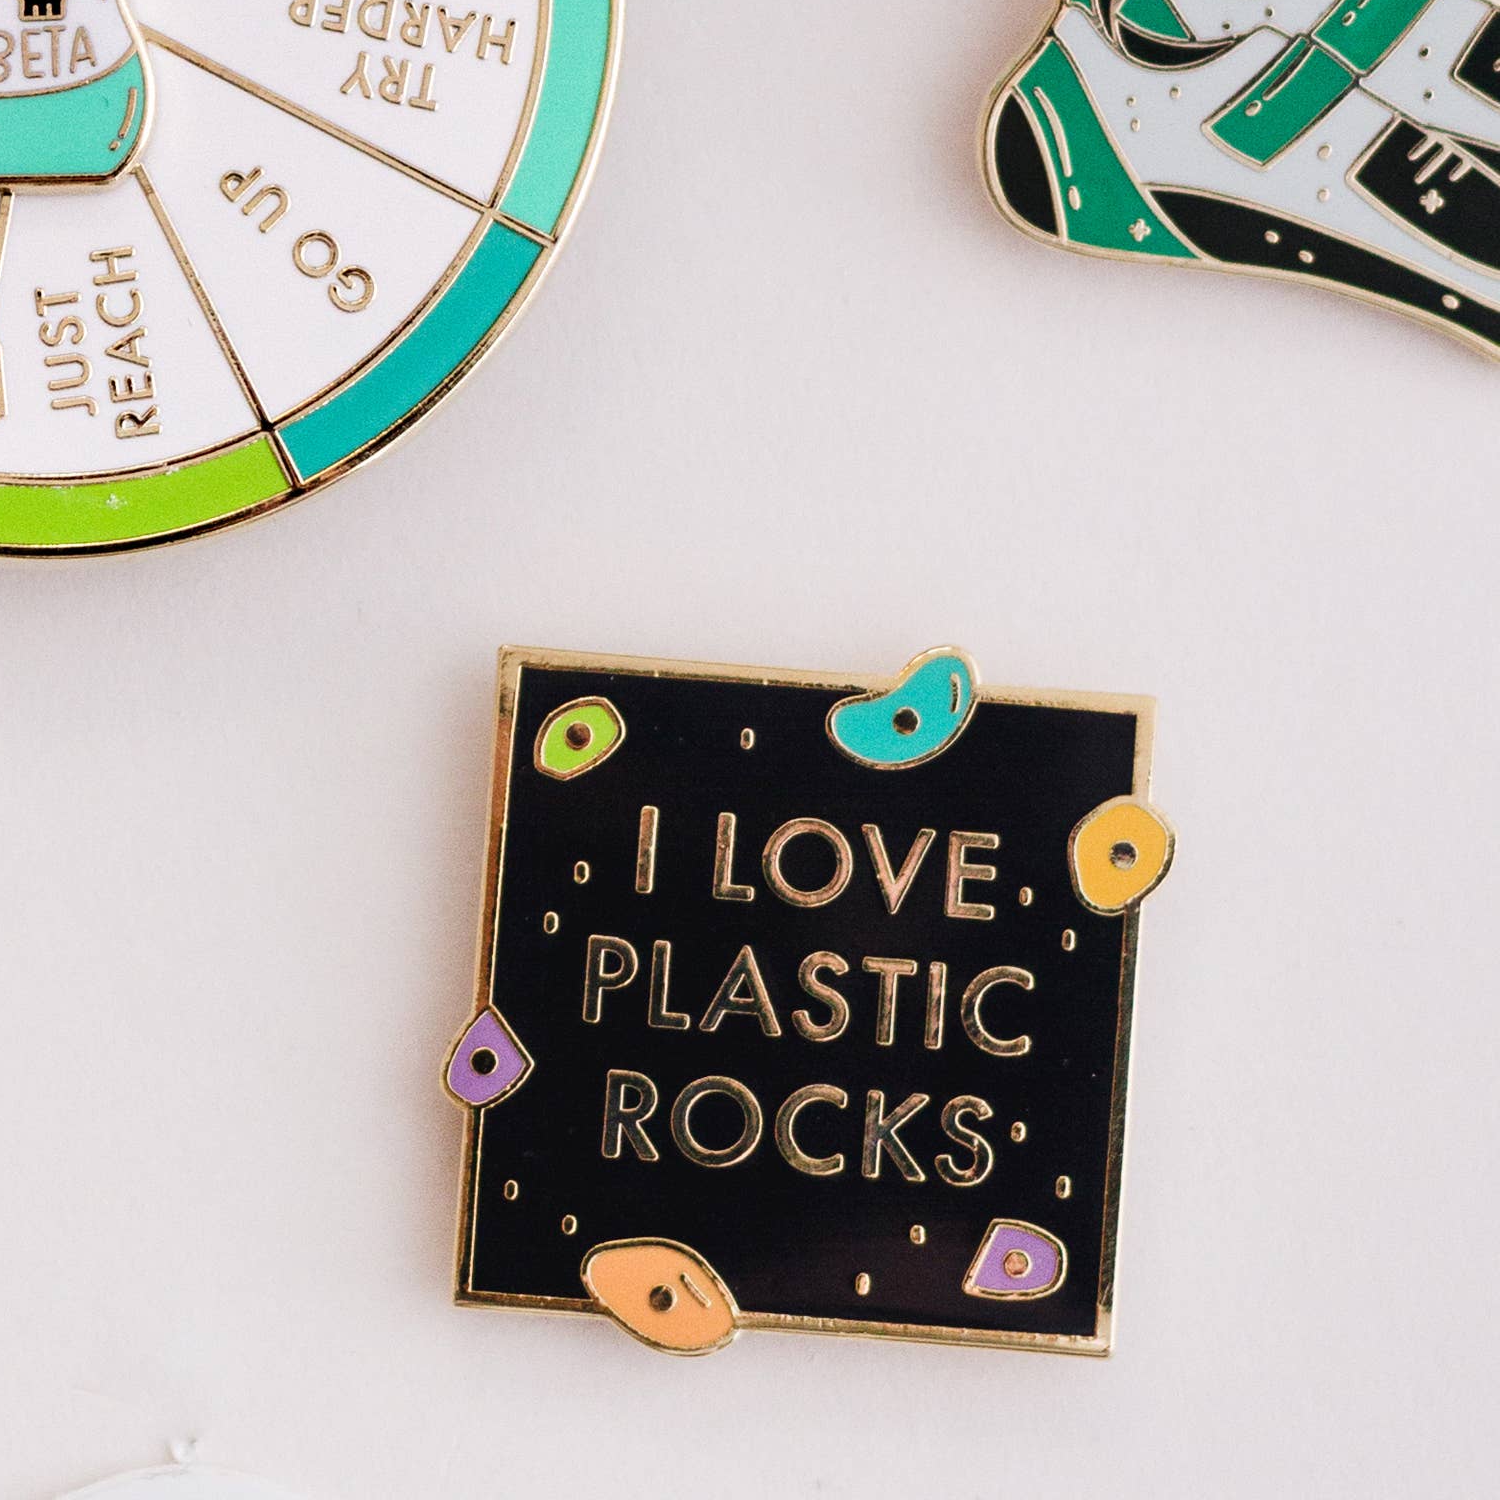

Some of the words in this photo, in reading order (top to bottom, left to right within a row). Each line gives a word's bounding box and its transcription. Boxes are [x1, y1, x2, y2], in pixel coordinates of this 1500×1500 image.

[340, 50, 440, 111] TRY
[220, 165, 291, 234] UP
[292, 229, 377, 313] GO
[35, 286, 98, 417] JUST
[89, 245, 163, 439] REACH
[635, 805, 659, 895] I
[713, 812, 999, 921] LOVE
[582, 934, 1035, 1056] PLASTIC
[601, 1069, 994, 1187] ROCKS
